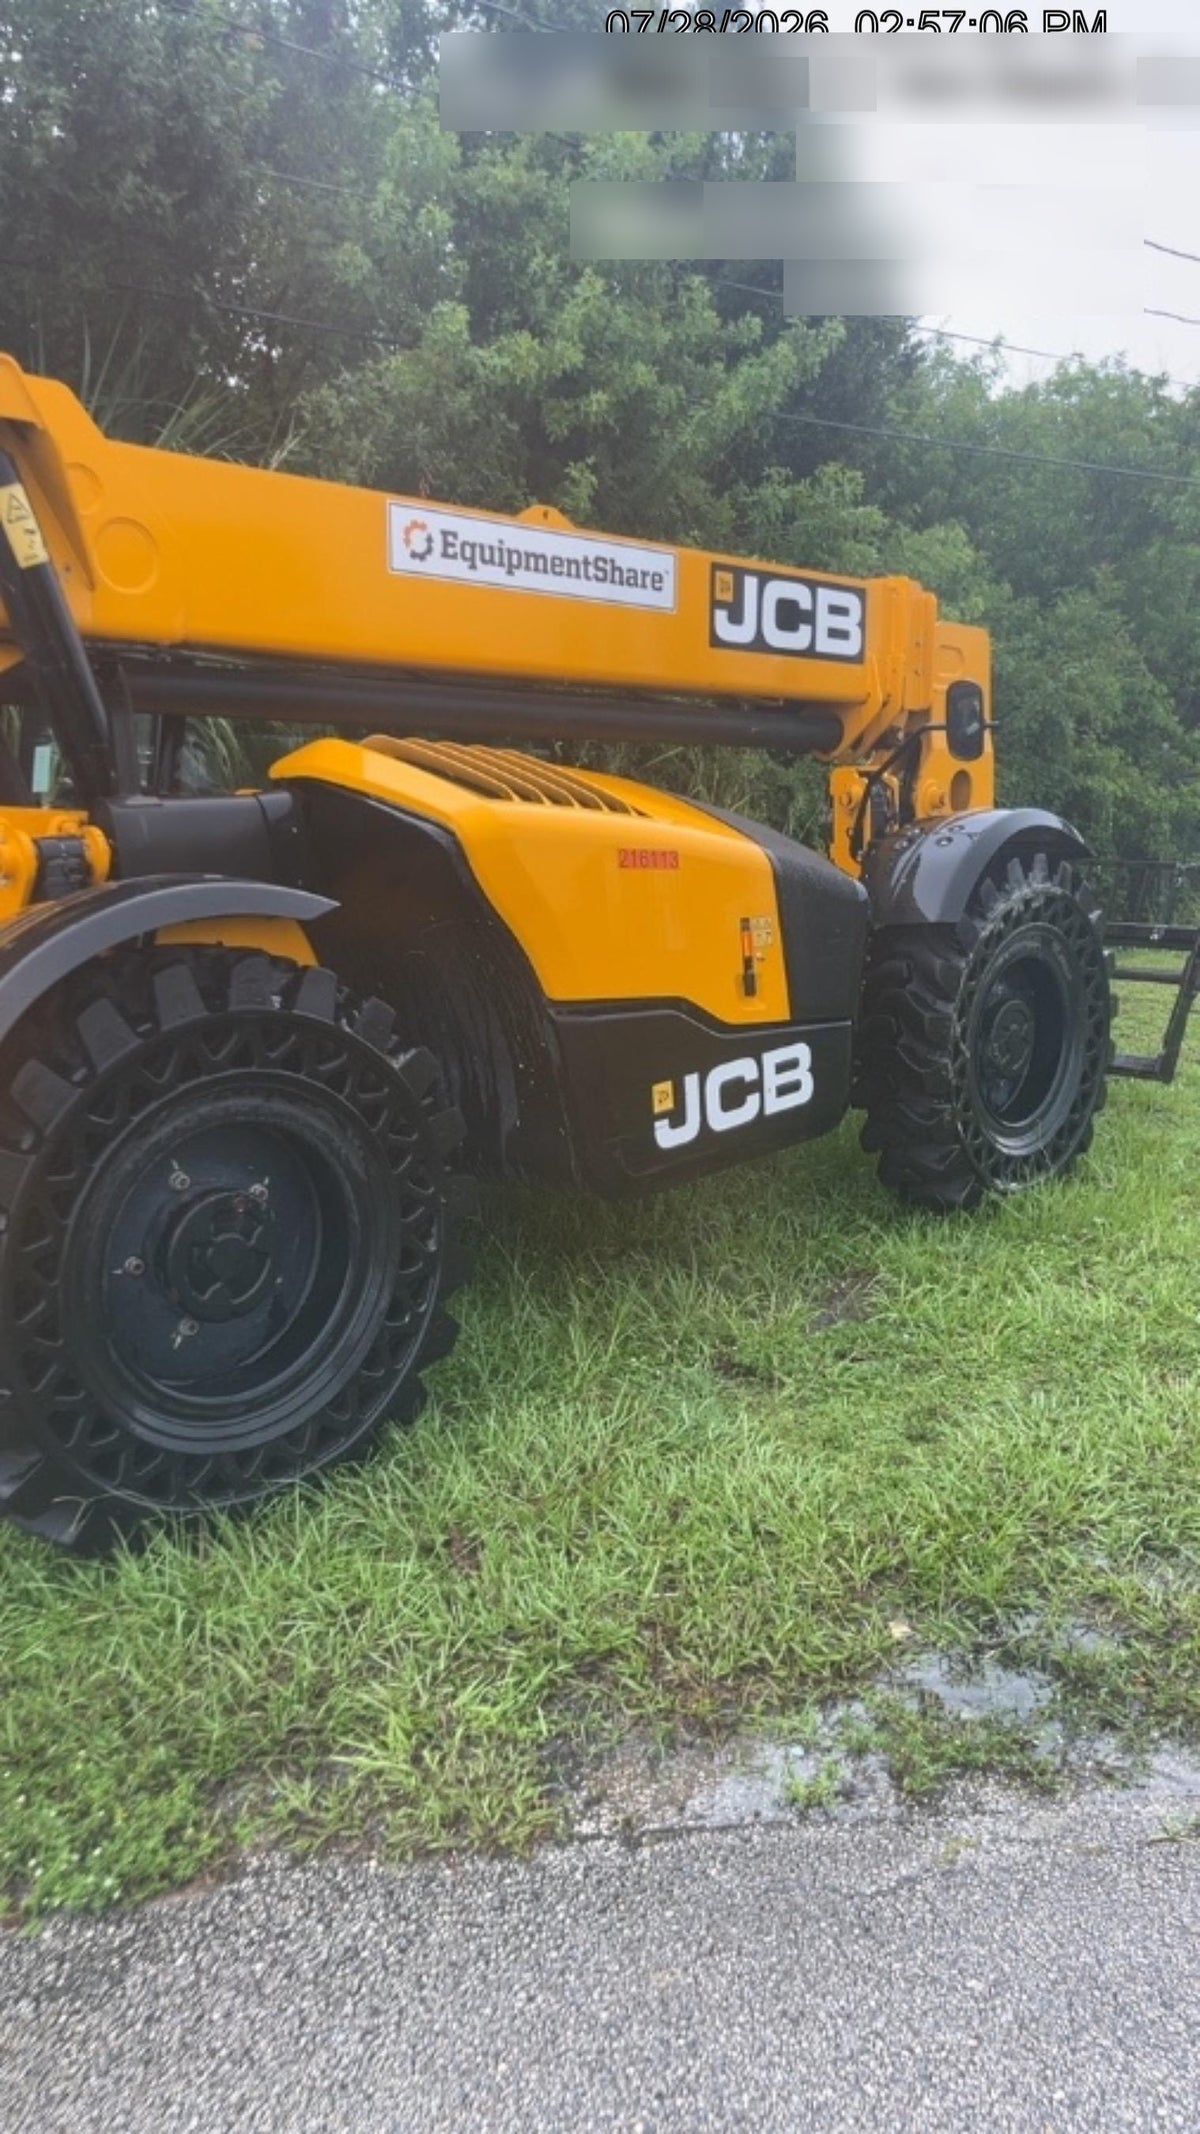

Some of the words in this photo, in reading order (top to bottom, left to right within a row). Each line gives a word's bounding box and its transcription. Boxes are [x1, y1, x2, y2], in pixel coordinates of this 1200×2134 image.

[440, 529, 664, 592] EquipmentShare
[714, 575, 862, 656] JCB
[653, 1042, 814, 1149] JCB
